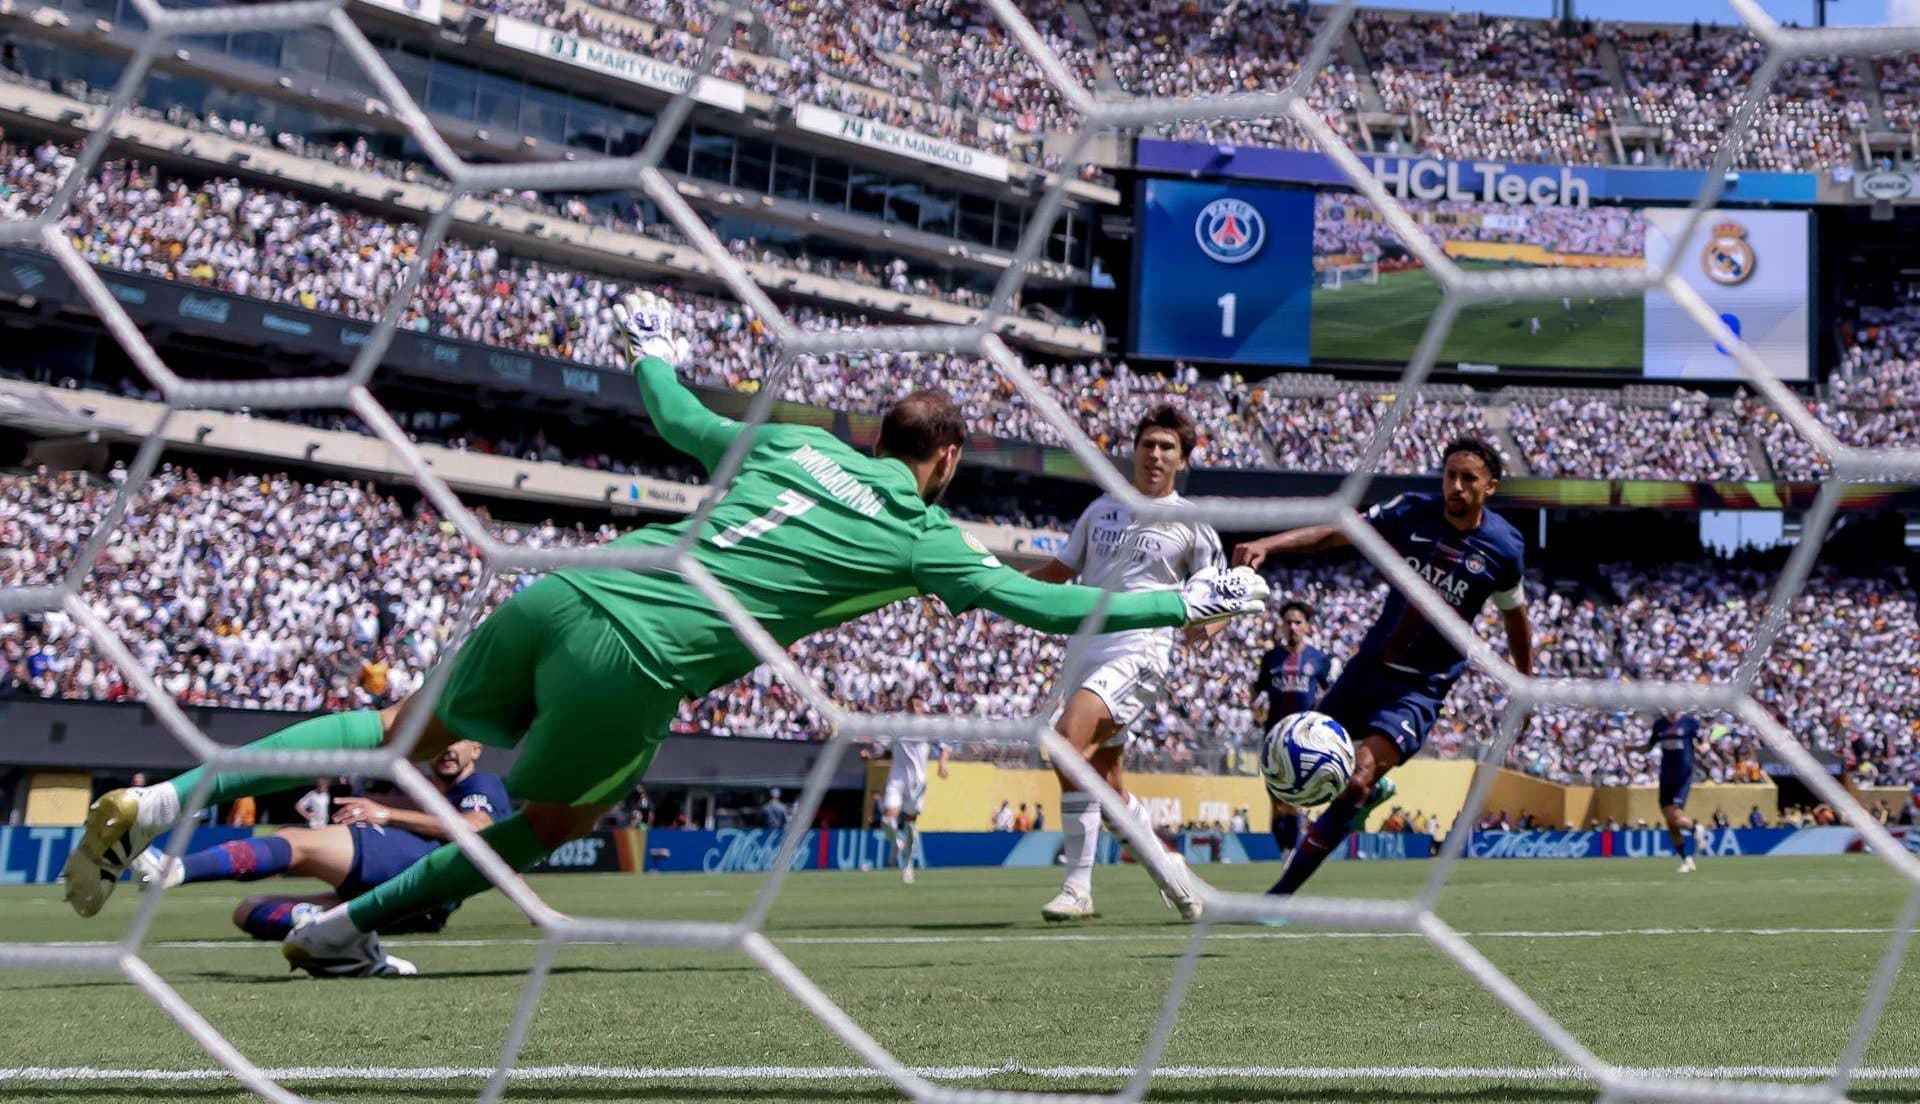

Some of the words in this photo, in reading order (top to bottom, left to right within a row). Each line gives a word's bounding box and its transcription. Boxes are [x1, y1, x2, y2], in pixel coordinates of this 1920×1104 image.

[587, 48, 647, 75] MARTY
[871, 128, 900, 146] NICK
[904, 137, 973, 166] MANGOLD
[1374, 158, 1589, 208] HCLTech
[1217, 293, 1236, 338] 1
[837, 829, 928, 870] ULTA
